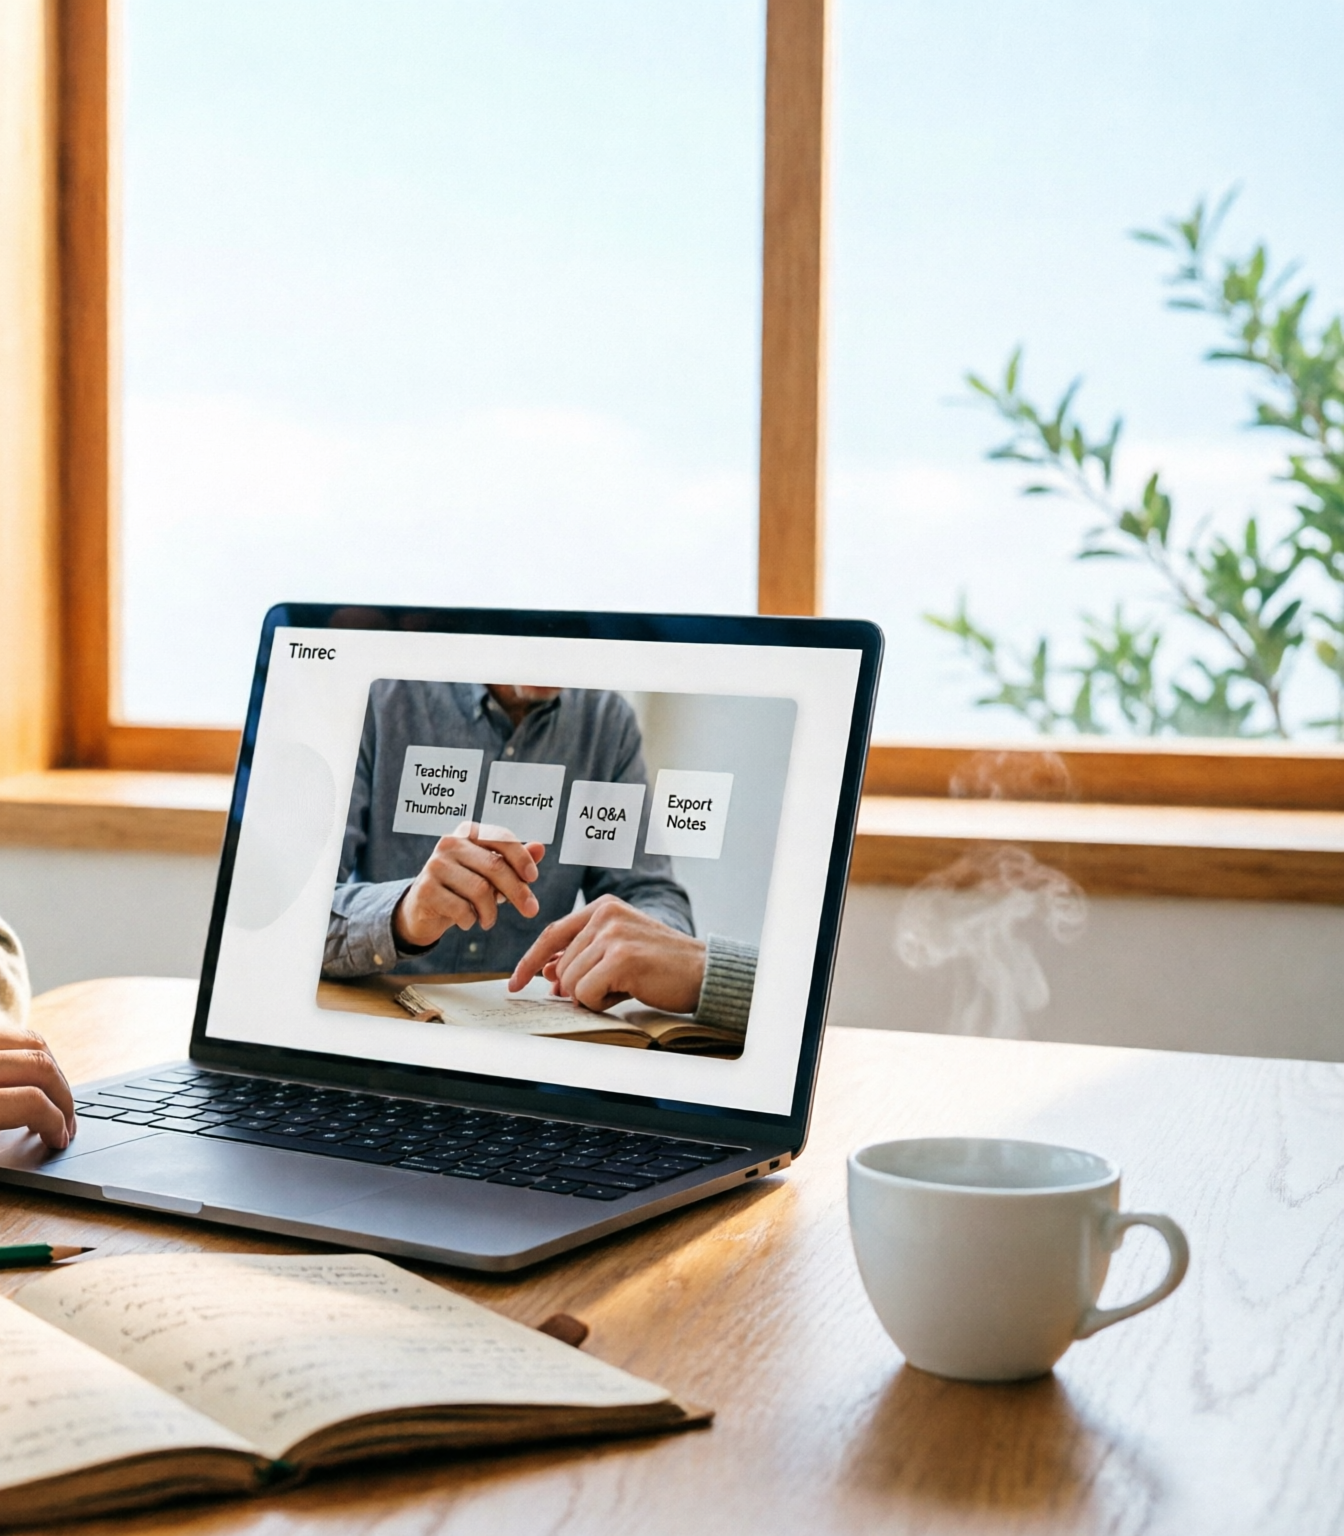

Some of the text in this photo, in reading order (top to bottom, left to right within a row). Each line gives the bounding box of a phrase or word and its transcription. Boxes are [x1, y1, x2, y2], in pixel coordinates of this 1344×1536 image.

[288, 642, 337, 661] Tinrec
[414, 763, 468, 783] Teaching
[420, 782, 455, 797] Video
[404, 799, 468, 817] Thumbnail
[491, 790, 554, 810] Transcript
[667, 794, 713, 813] Export
[579, 805, 627, 822] AI Q&A
[666, 815, 707, 831] Notes
[585, 825, 617, 841] Card
